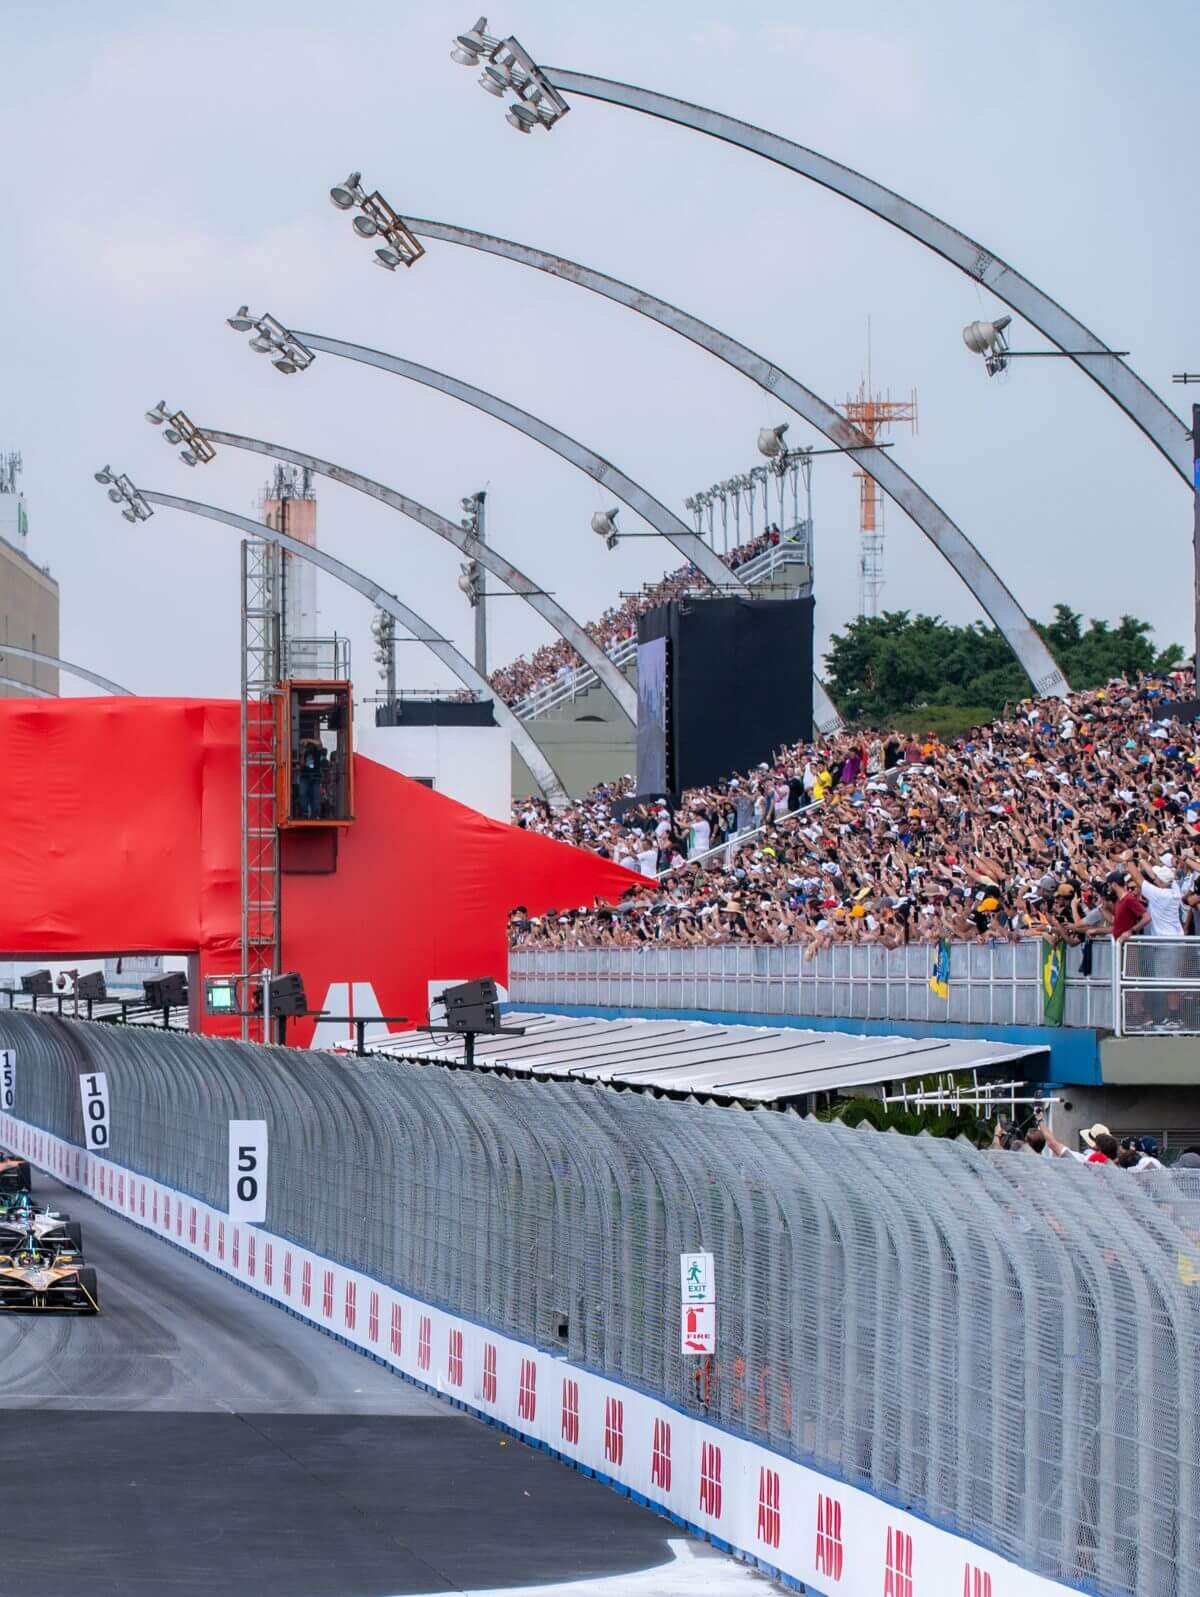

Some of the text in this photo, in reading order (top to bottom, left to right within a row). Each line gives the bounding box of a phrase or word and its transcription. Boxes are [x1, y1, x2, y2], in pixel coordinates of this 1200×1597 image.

[2, 1051, 13, 1107] 150
[86, 1076, 107, 1146] 100
[237, 1146, 258, 1202] 50
[518, 1358, 536, 1422] ABB
[561, 1377, 579, 1445] ABB
[604, 1395, 624, 1466] ABB
[651, 1417, 671, 1492] ABB
[700, 1440, 722, 1520] ABB
[757, 1466, 781, 1549] ABB
[815, 1493, 843, 1582] ABB
